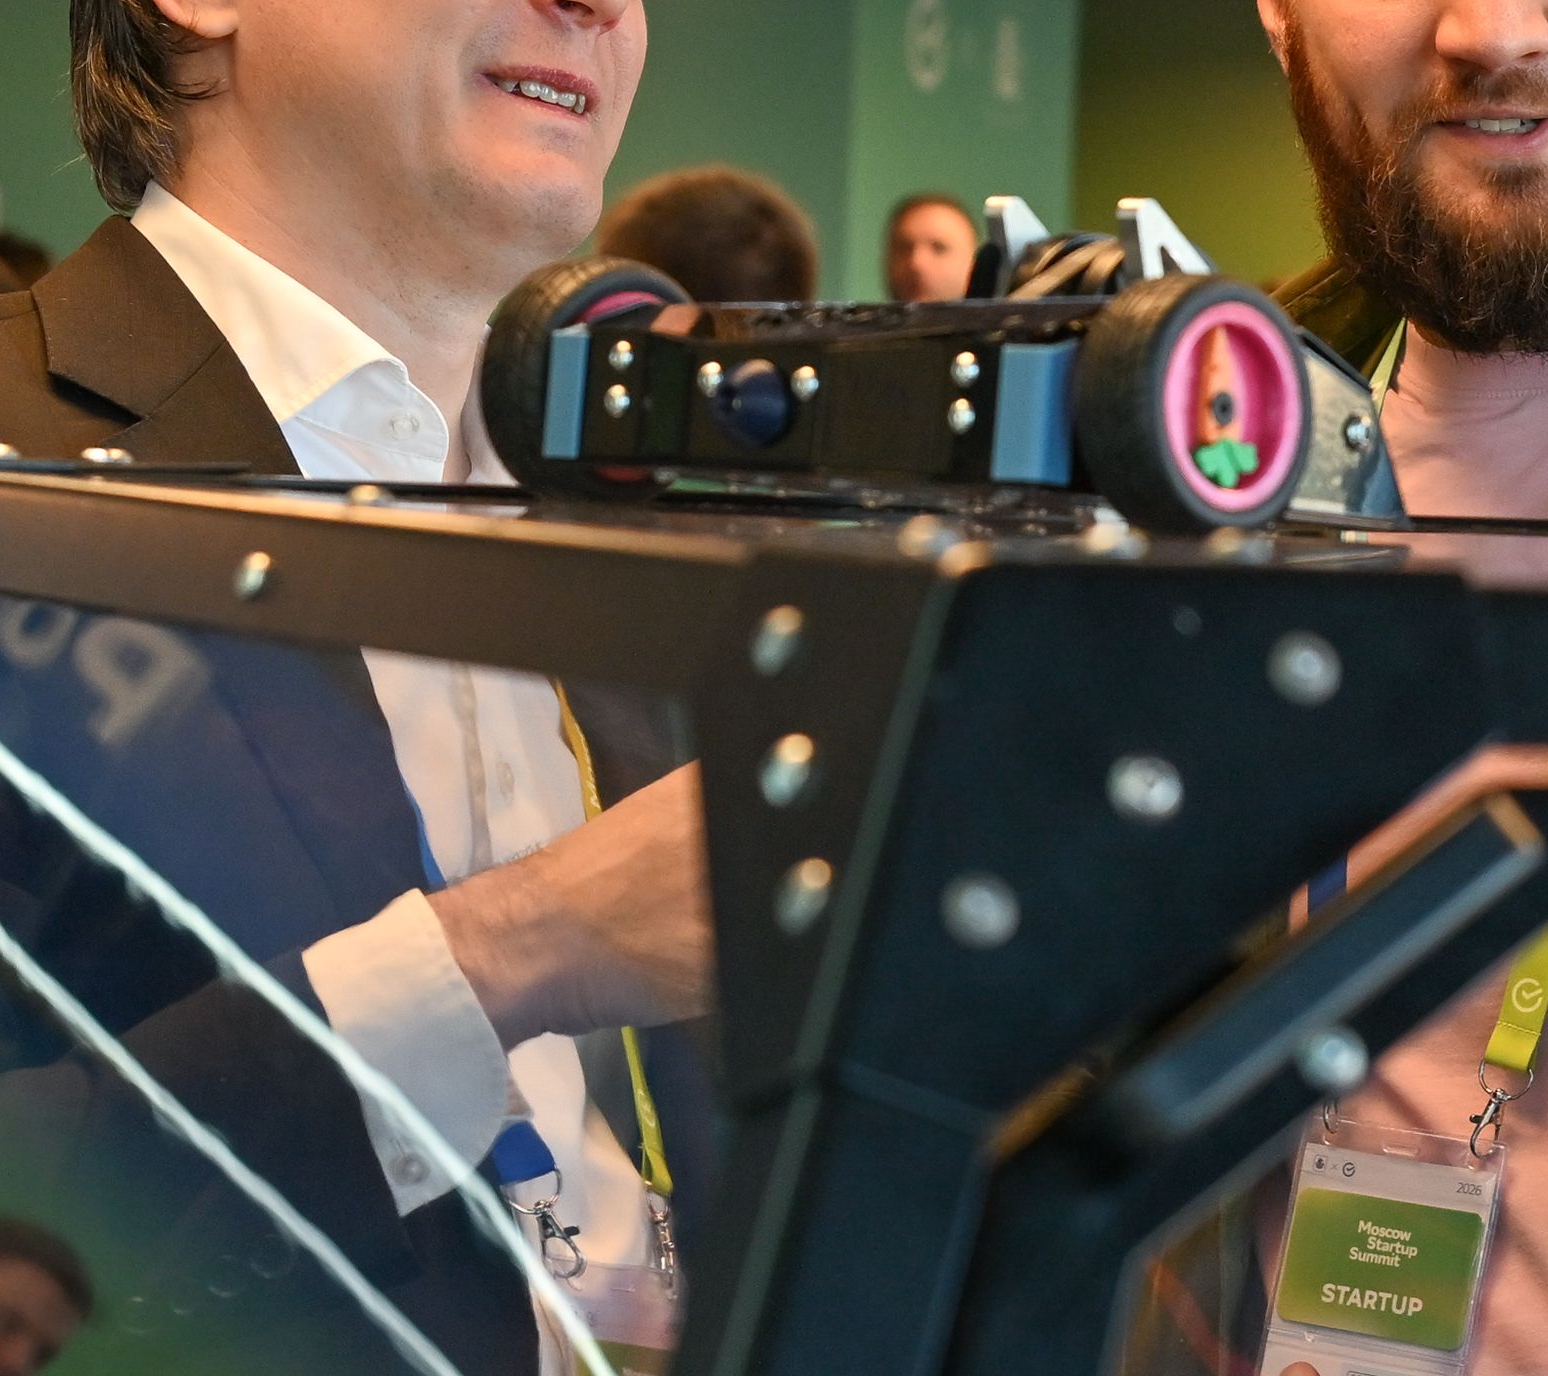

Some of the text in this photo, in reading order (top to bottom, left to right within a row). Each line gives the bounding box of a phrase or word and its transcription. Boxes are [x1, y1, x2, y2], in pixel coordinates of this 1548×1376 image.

[1456, 1182, 1483, 1196] 2026
[1357, 1220, 1412, 1242] Moscow
[1349, 1246, 1402, 1267] Summit
[1366, 1237, 1418, 1259] Startup
[1320, 1282, 1424, 1316] STARTUP
